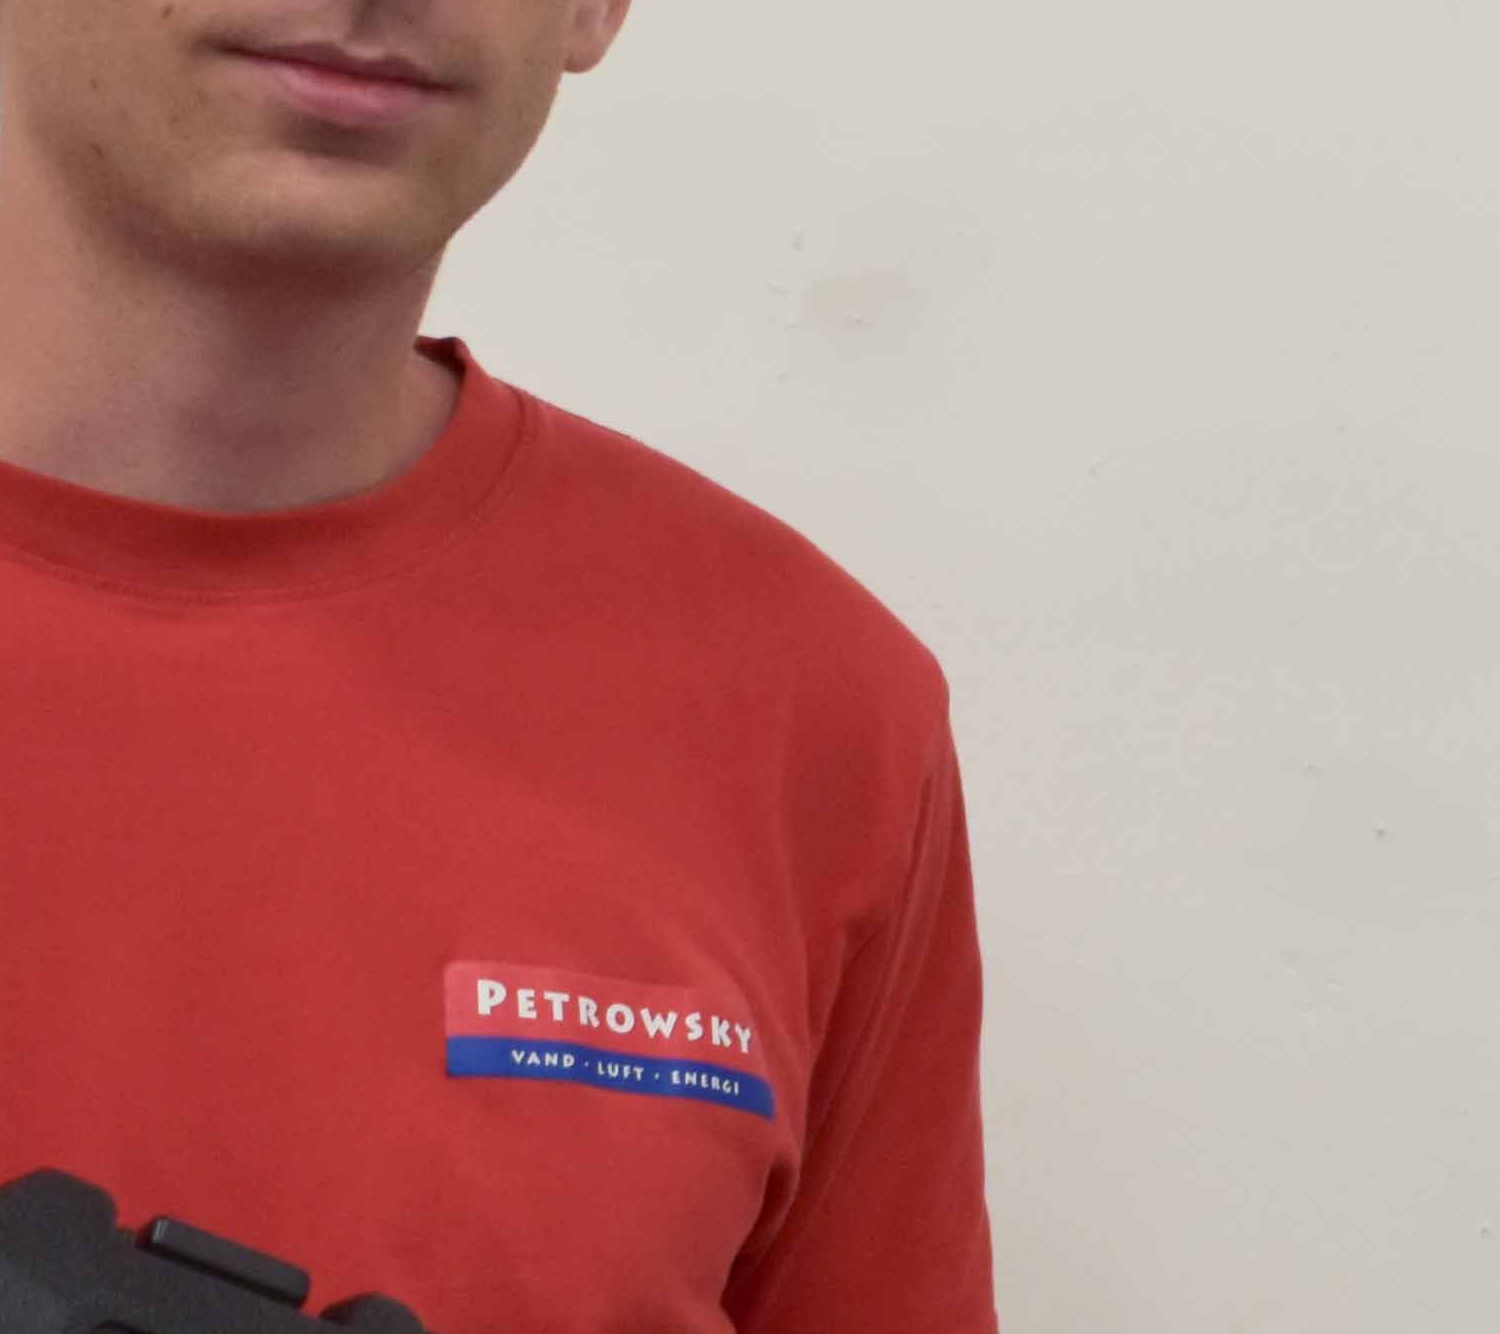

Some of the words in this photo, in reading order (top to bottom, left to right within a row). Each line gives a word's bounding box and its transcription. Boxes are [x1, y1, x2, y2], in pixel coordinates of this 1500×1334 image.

[476, 978, 752, 1054] PETROWSKY
[512, 1050, 576, 1068] VAND
[597, 1062, 645, 1082] LUFT
[671, 1070, 741, 1096] ENERGI
